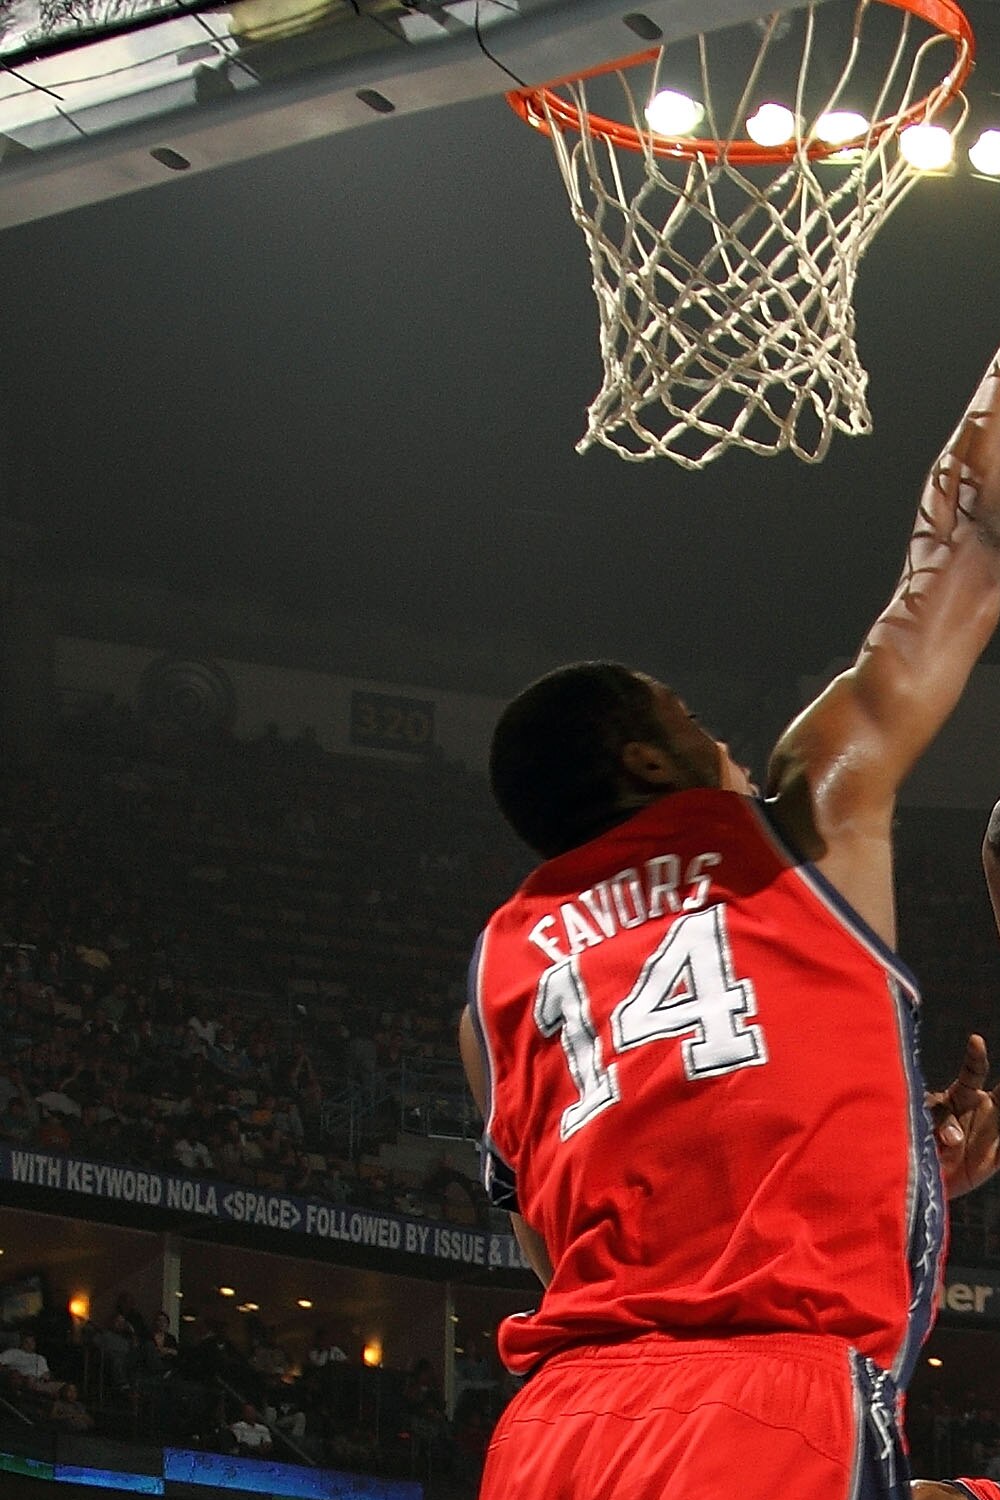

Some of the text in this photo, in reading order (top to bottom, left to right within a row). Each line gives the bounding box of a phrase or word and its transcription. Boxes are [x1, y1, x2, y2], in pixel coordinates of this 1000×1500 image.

[528, 852, 722, 963] FAVORS
[533, 902, 768, 1141] 14
[11, 1151, 62, 1189] WITH
[67, 1160, 162, 1206] KEYWORD
[166, 1178, 219, 1216] NOLA
[224, 1190, 301, 1230] <SPACE>
[306, 1204, 400, 1251] FOLLOWED
[405, 1222, 430, 1255] BY
[434, 1228, 484, 1266] ISSUE
[488, 1236, 504, 1266] &
